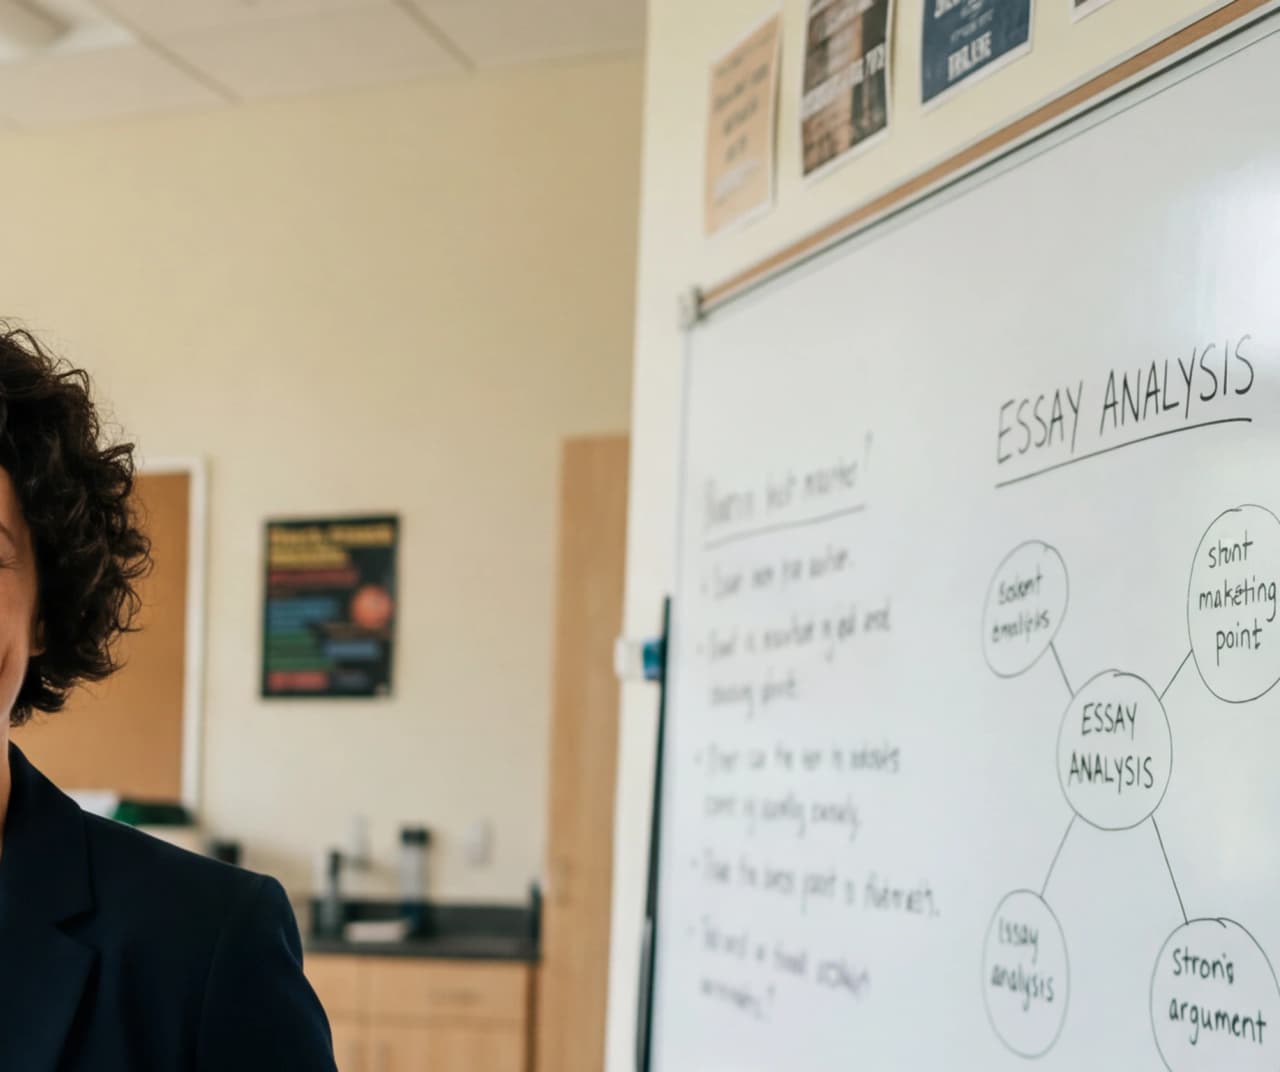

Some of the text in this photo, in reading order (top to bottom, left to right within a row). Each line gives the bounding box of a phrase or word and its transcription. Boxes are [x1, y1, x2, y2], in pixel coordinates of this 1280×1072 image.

[997, 334, 1255, 464] ESSAY ANALYSIS
[1216, 618, 1263, 667] point
[1081, 702, 1138, 741] ESSAY
[1068, 750, 1154, 795] ANALYSIS
[1168, 998, 1267, 1046] argument
